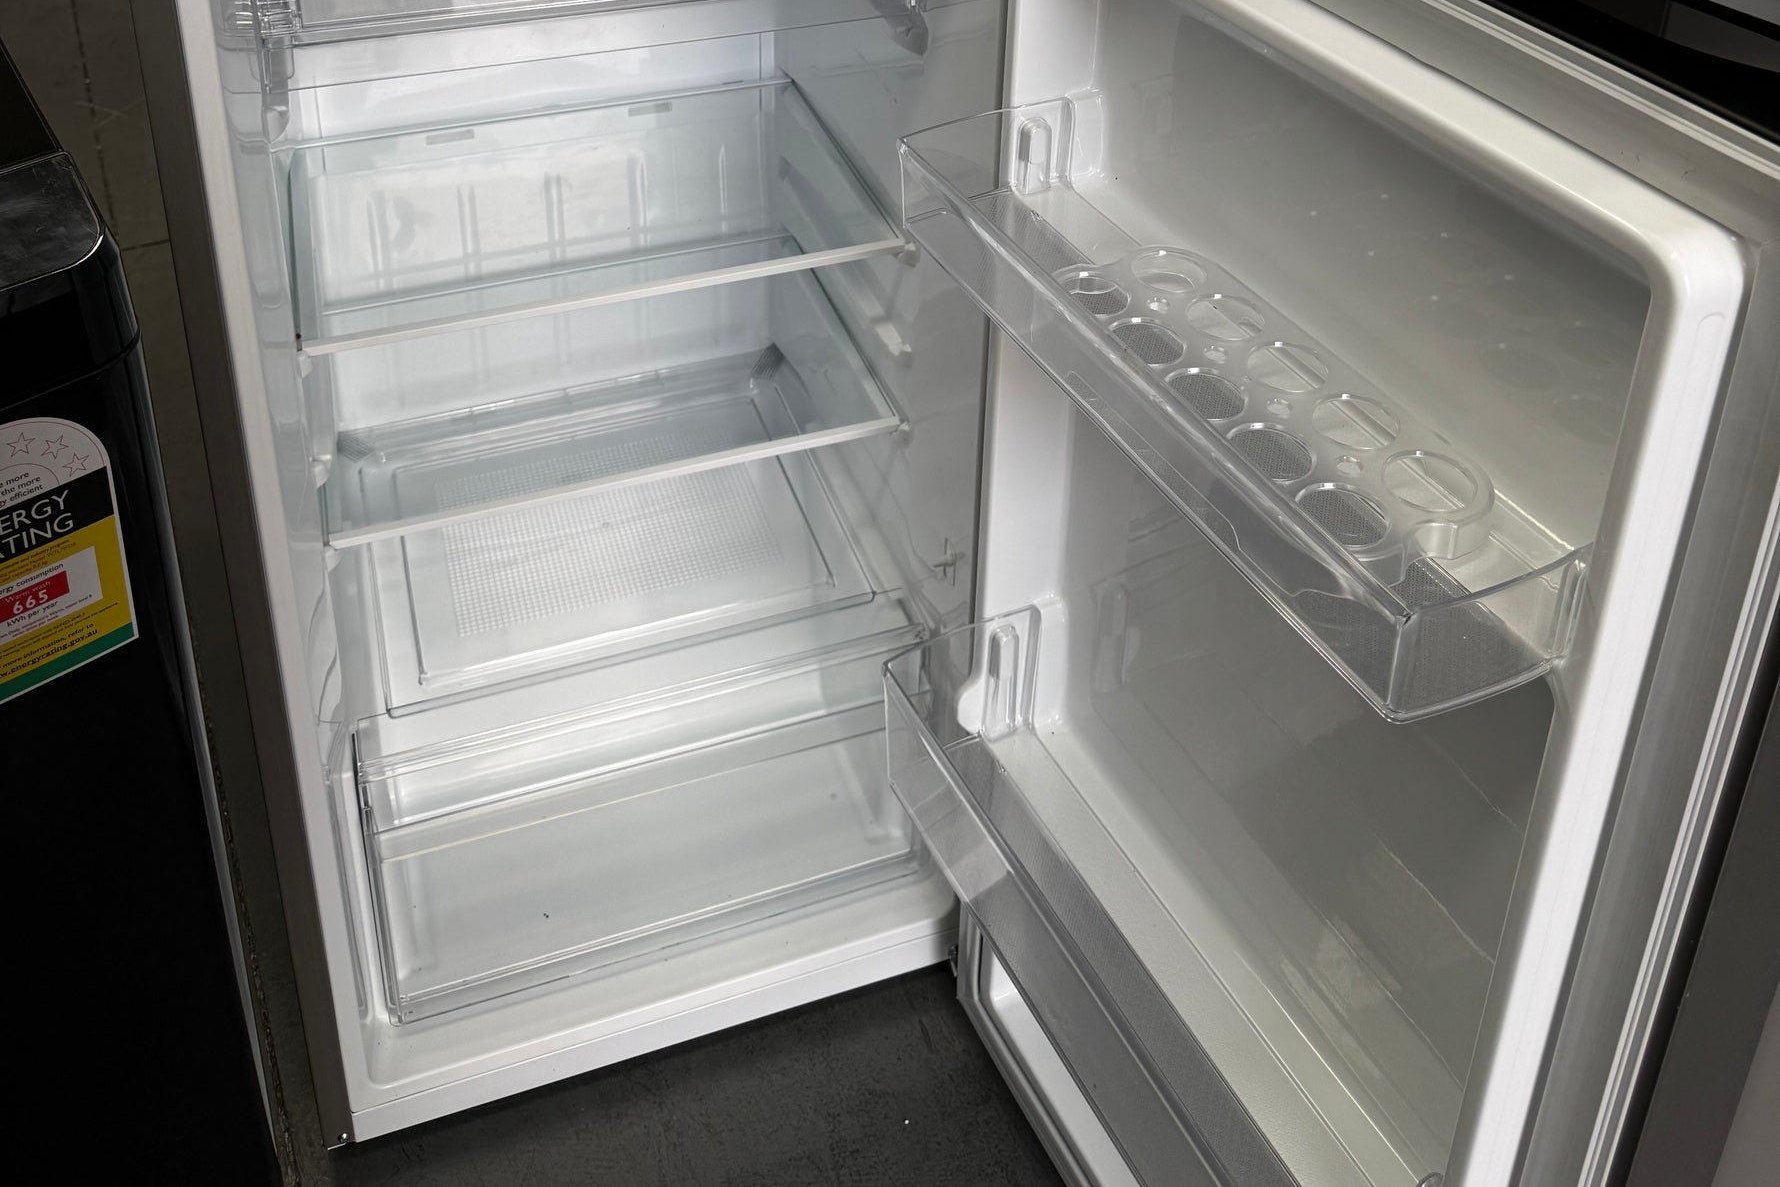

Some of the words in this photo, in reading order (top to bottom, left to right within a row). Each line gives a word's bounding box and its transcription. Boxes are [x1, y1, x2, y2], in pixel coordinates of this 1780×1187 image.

[6, 472, 29, 485] more
[17, 476, 41, 489] more
[10, 483, 43, 502] efficient
[16, 563, 64, 588] consumption
[4, 589, 30, 603] Warm
[13, 589, 49, 615] 665
[6, 615, 26, 627] kWh
[27, 609, 40, 619] per
[42, 600, 58, 613] year
[23, 638, 67, 660] information,
[68, 627, 85, 638] refer
